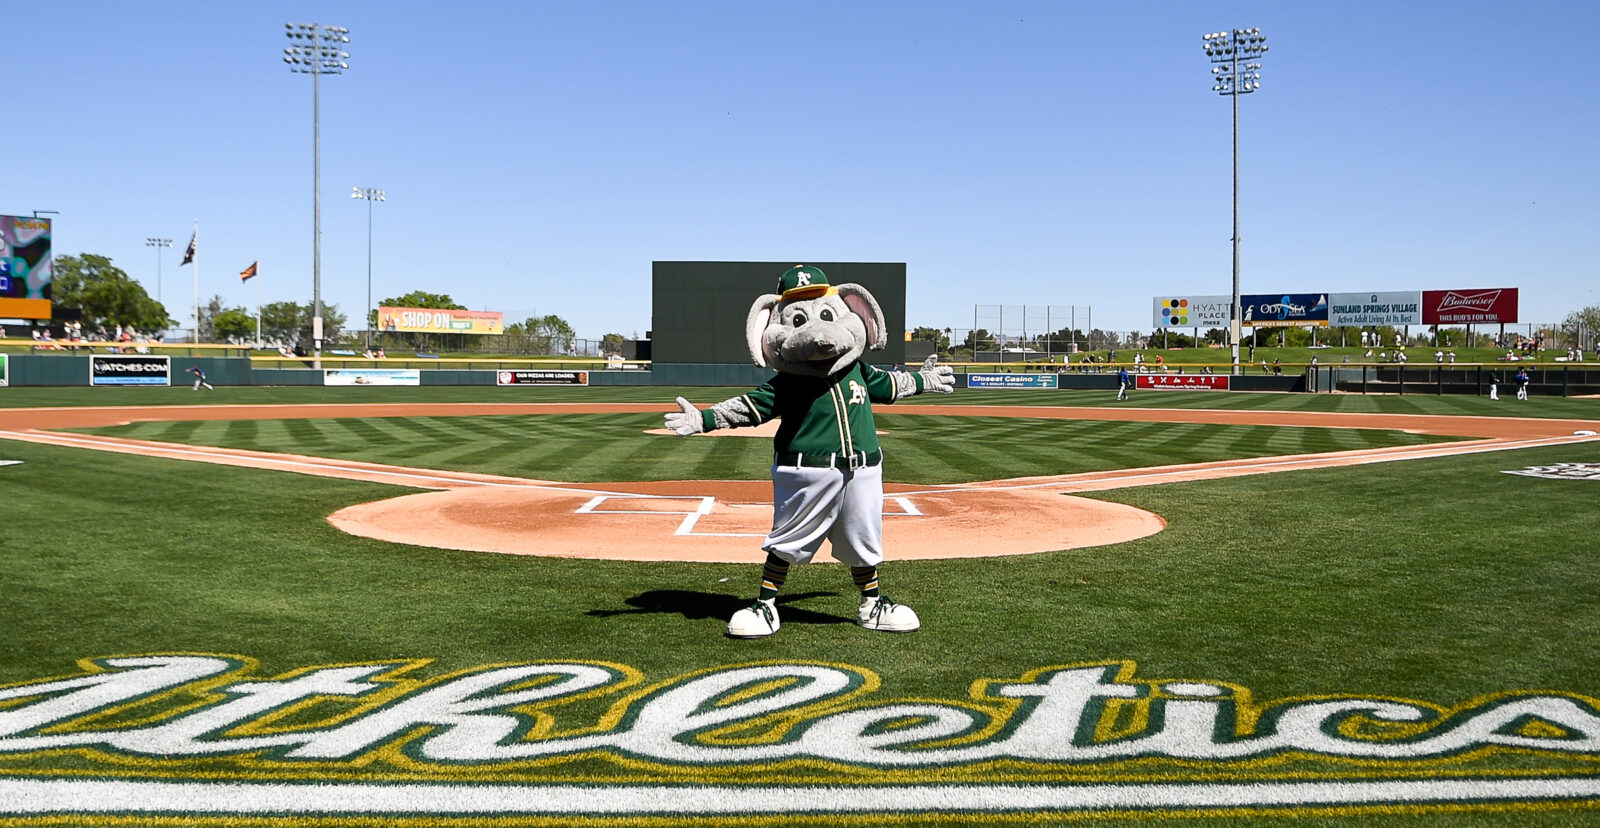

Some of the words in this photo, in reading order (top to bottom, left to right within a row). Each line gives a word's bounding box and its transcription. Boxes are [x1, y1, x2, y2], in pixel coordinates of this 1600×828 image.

[797, 271, 812, 287] A's
[1442, 296, 1494, 306] Budweiser
[1193, 304, 1229, 312] HYATT
[1332, 305, 1361, 314] SUNLAND
[1363, 304, 1390, 313] SPRINGS
[1391, 304, 1417, 313] VILLAGE
[402, 311, 432, 328] SHOP
[434, 313, 451, 329] ON
[1338, 315, 1353, 323] Active
[1354, 315, 1367, 323] Adult
[1368, 315, 1384, 324] Living
[1385, 315, 1392, 323] At
[1400, 314, 1412, 322] Best
[848, 380, 867, 405] A's
